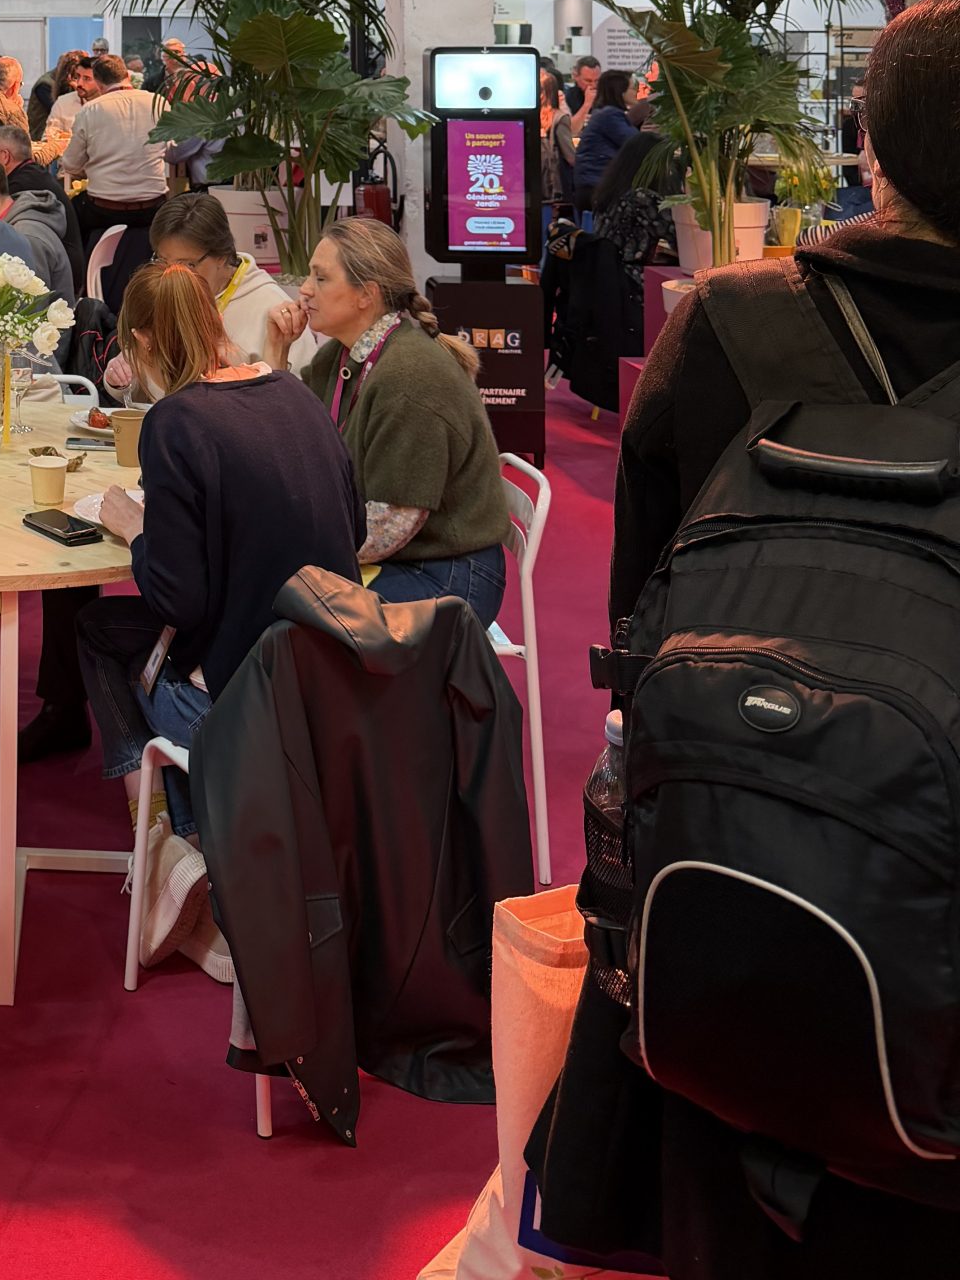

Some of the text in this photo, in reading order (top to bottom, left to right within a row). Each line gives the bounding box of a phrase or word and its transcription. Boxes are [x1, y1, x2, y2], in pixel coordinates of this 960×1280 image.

[476, 132, 505, 140] souvenir
[472, 140, 501, 148] partager
[469, 174, 500, 193] 20
[466, 193, 508, 201] Génération
[480, 387, 526, 397] PARTENAIRE
